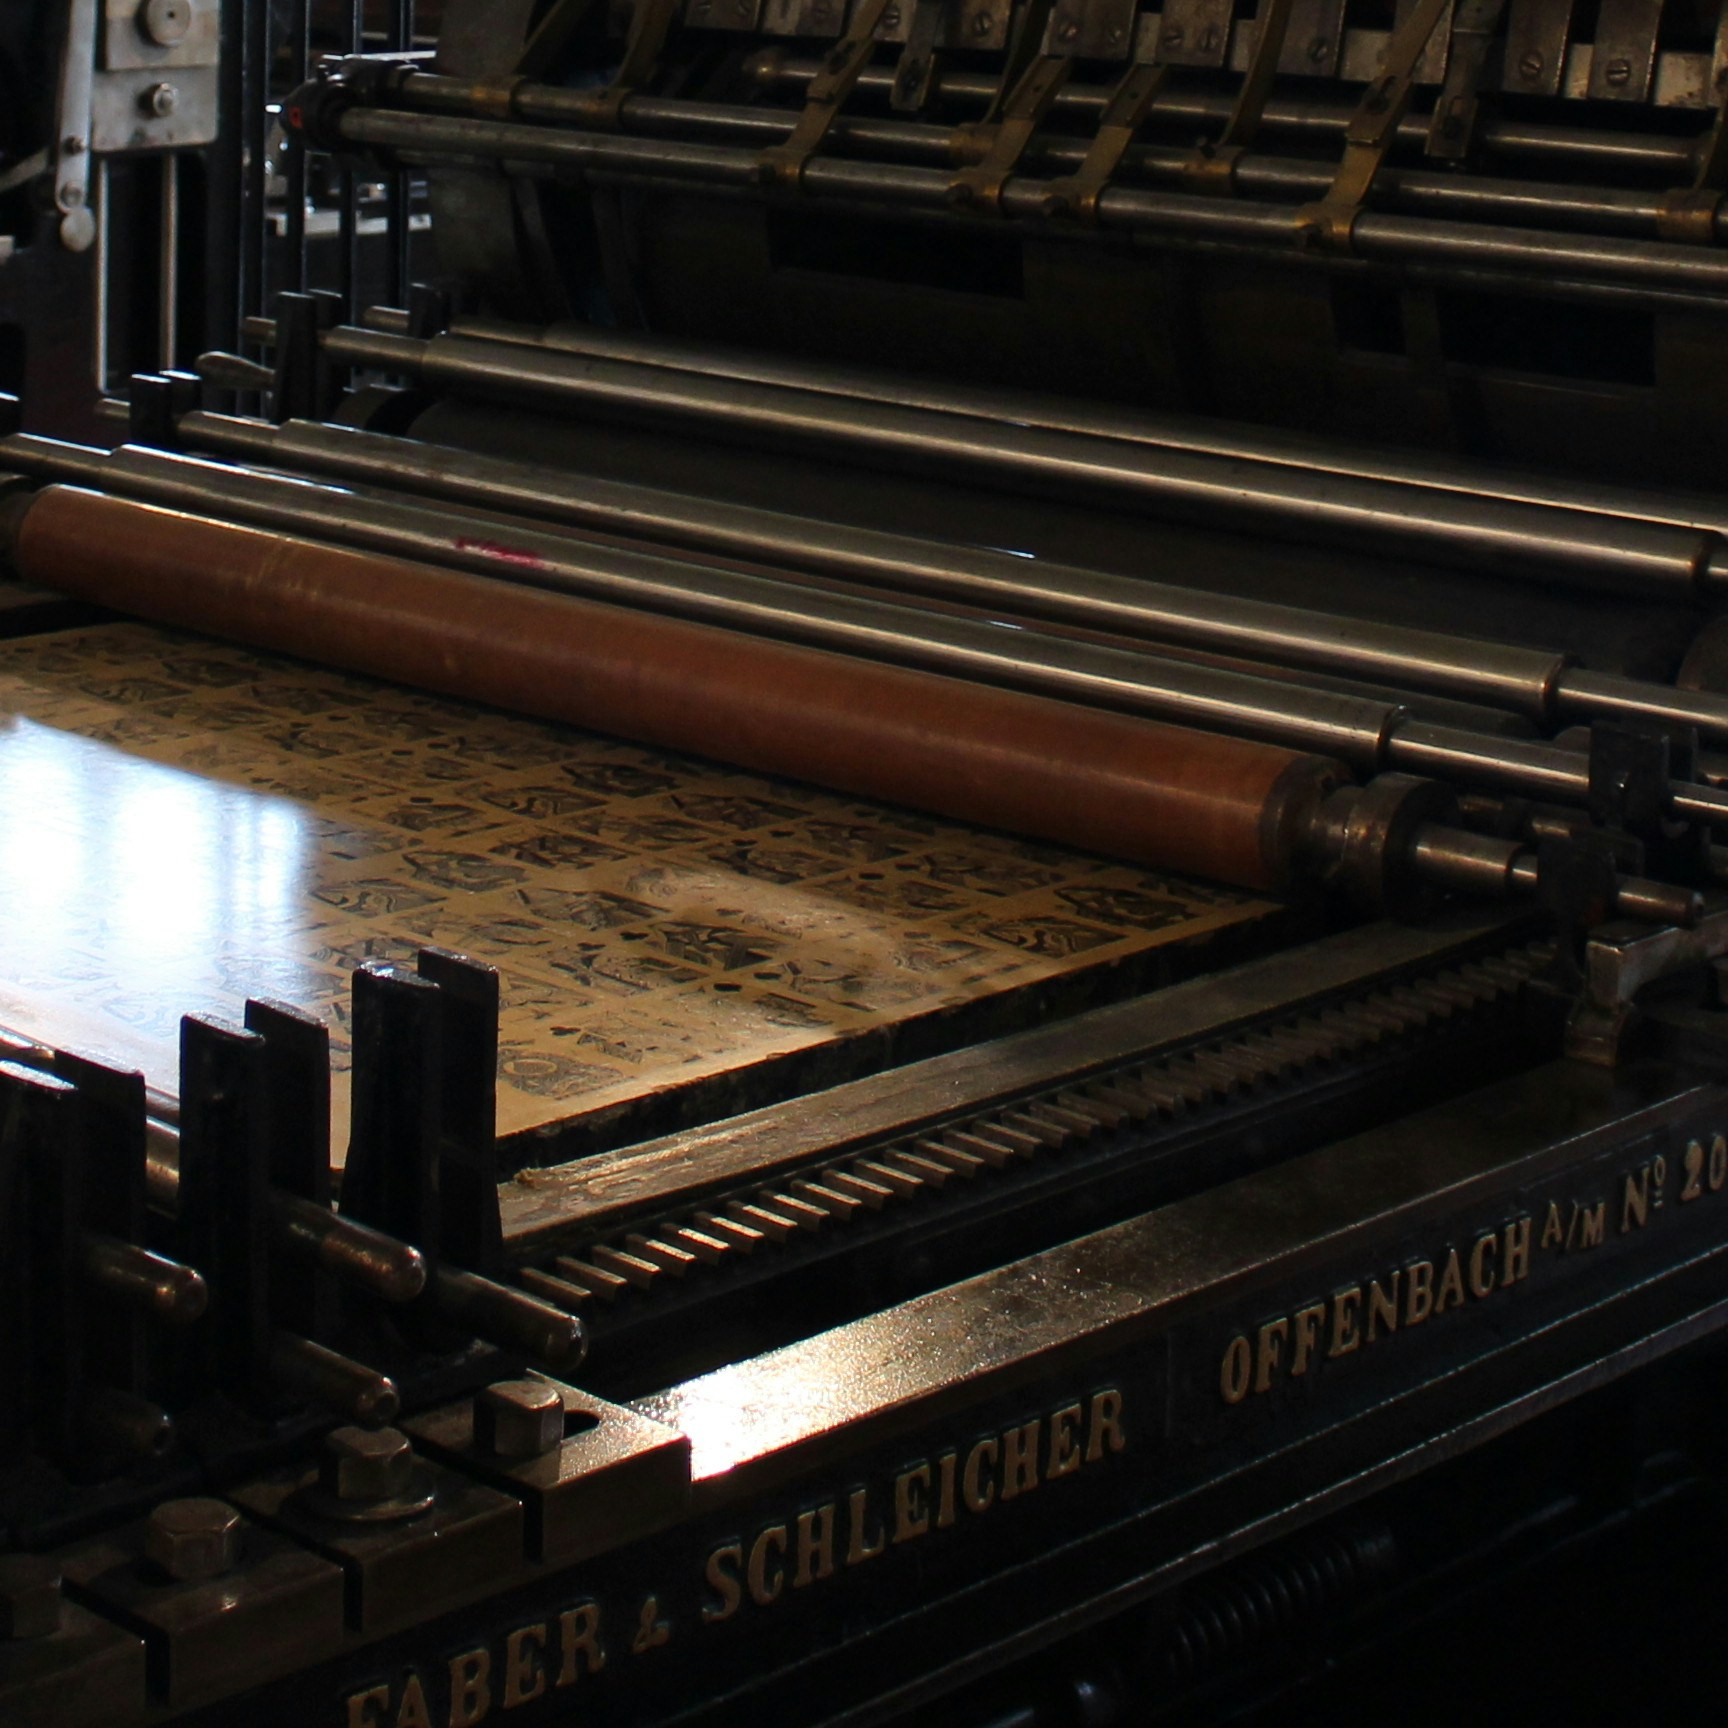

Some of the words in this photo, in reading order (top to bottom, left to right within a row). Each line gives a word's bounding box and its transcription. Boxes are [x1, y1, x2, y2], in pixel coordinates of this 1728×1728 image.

[631, 1595, 670, 1656] &
[701, 1386, 1126, 1624] SCHLEICHER
[1220, 1215, 1532, 1405] OFFENBACH
